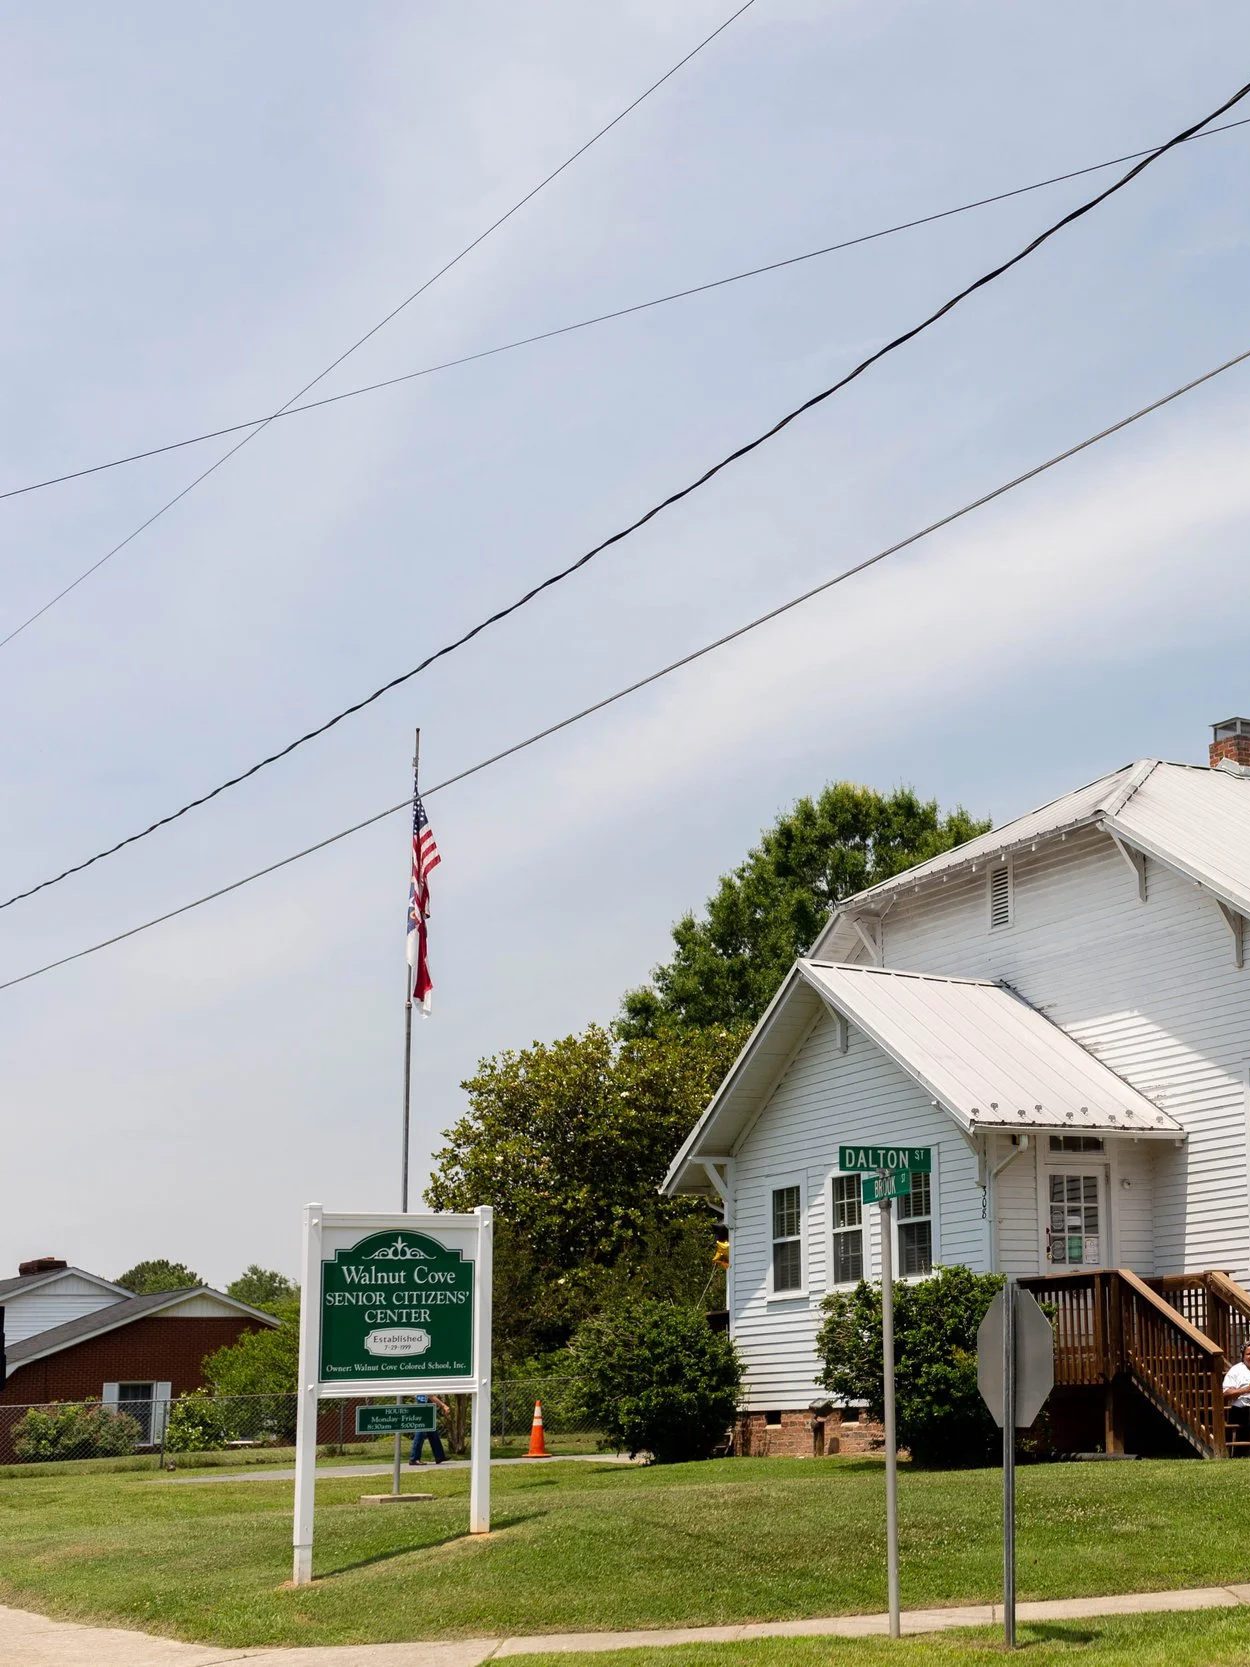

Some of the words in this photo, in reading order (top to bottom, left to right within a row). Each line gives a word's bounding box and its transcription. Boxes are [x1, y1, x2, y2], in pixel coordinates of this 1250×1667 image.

[845, 1149, 909, 1169] DALTON
[914, 1149, 925, 1160] ST
[874, 1175, 897, 1198] BROOK
[901, 1172, 906, 1183] ST
[341, 1265, 407, 1285] Walnut
[413, 1265, 456, 1284] Cove
[325, 1291, 387, 1306] SENIOR
[392, 1290, 470, 1305] CITIZENS'
[364, 1309, 432, 1323] CENTER
[373, 1334, 423, 1343] Established
[326, 1364, 352, 1373] Owner:
[354, 1363, 379, 1372] Walnut
[381, 1363, 398, 1371] Cove
[400, 1362, 426, 1371] Colored
[427, 1361, 452, 1370] School,
[453, 1360, 467, 1369] Inc.
